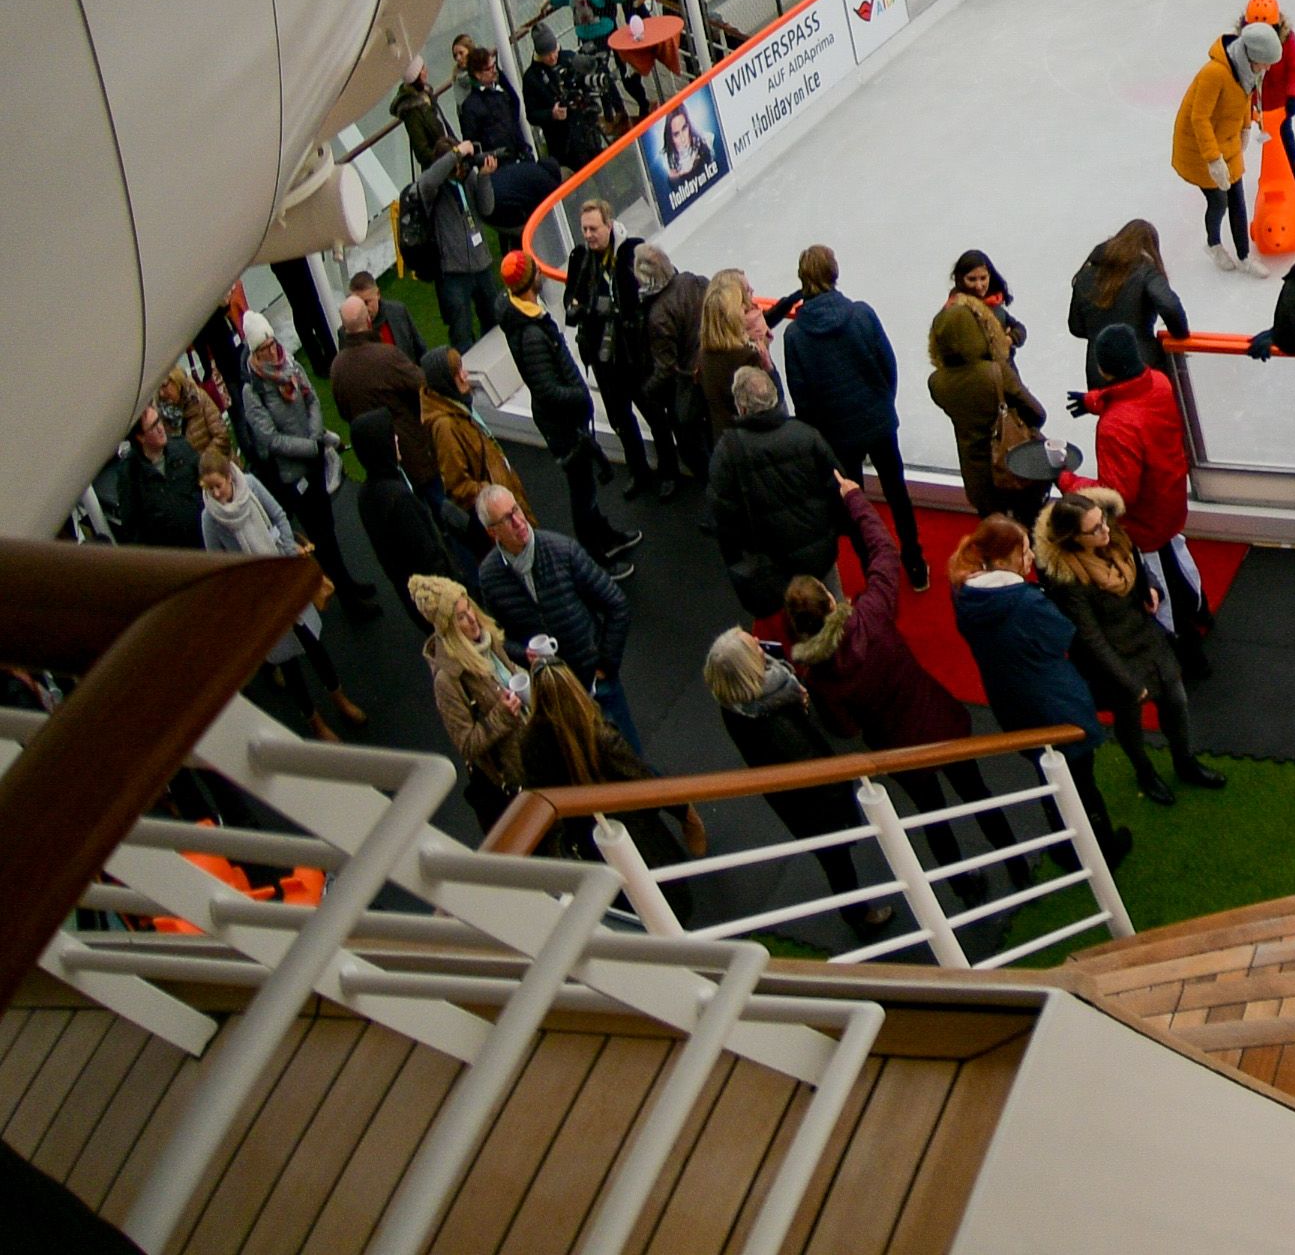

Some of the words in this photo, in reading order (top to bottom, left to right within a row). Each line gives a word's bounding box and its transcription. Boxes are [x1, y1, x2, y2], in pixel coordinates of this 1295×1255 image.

[724, 10, 821, 97] WINTERSPASS
[767, 72, 786, 94] AUF
[788, 32, 835, 78] AIDAprima
[733, 131, 751, 156] MIT
[752, 92, 795, 138] Holiday
[794, 86, 805, 106] on
[804, 70, 821, 98] Ice
